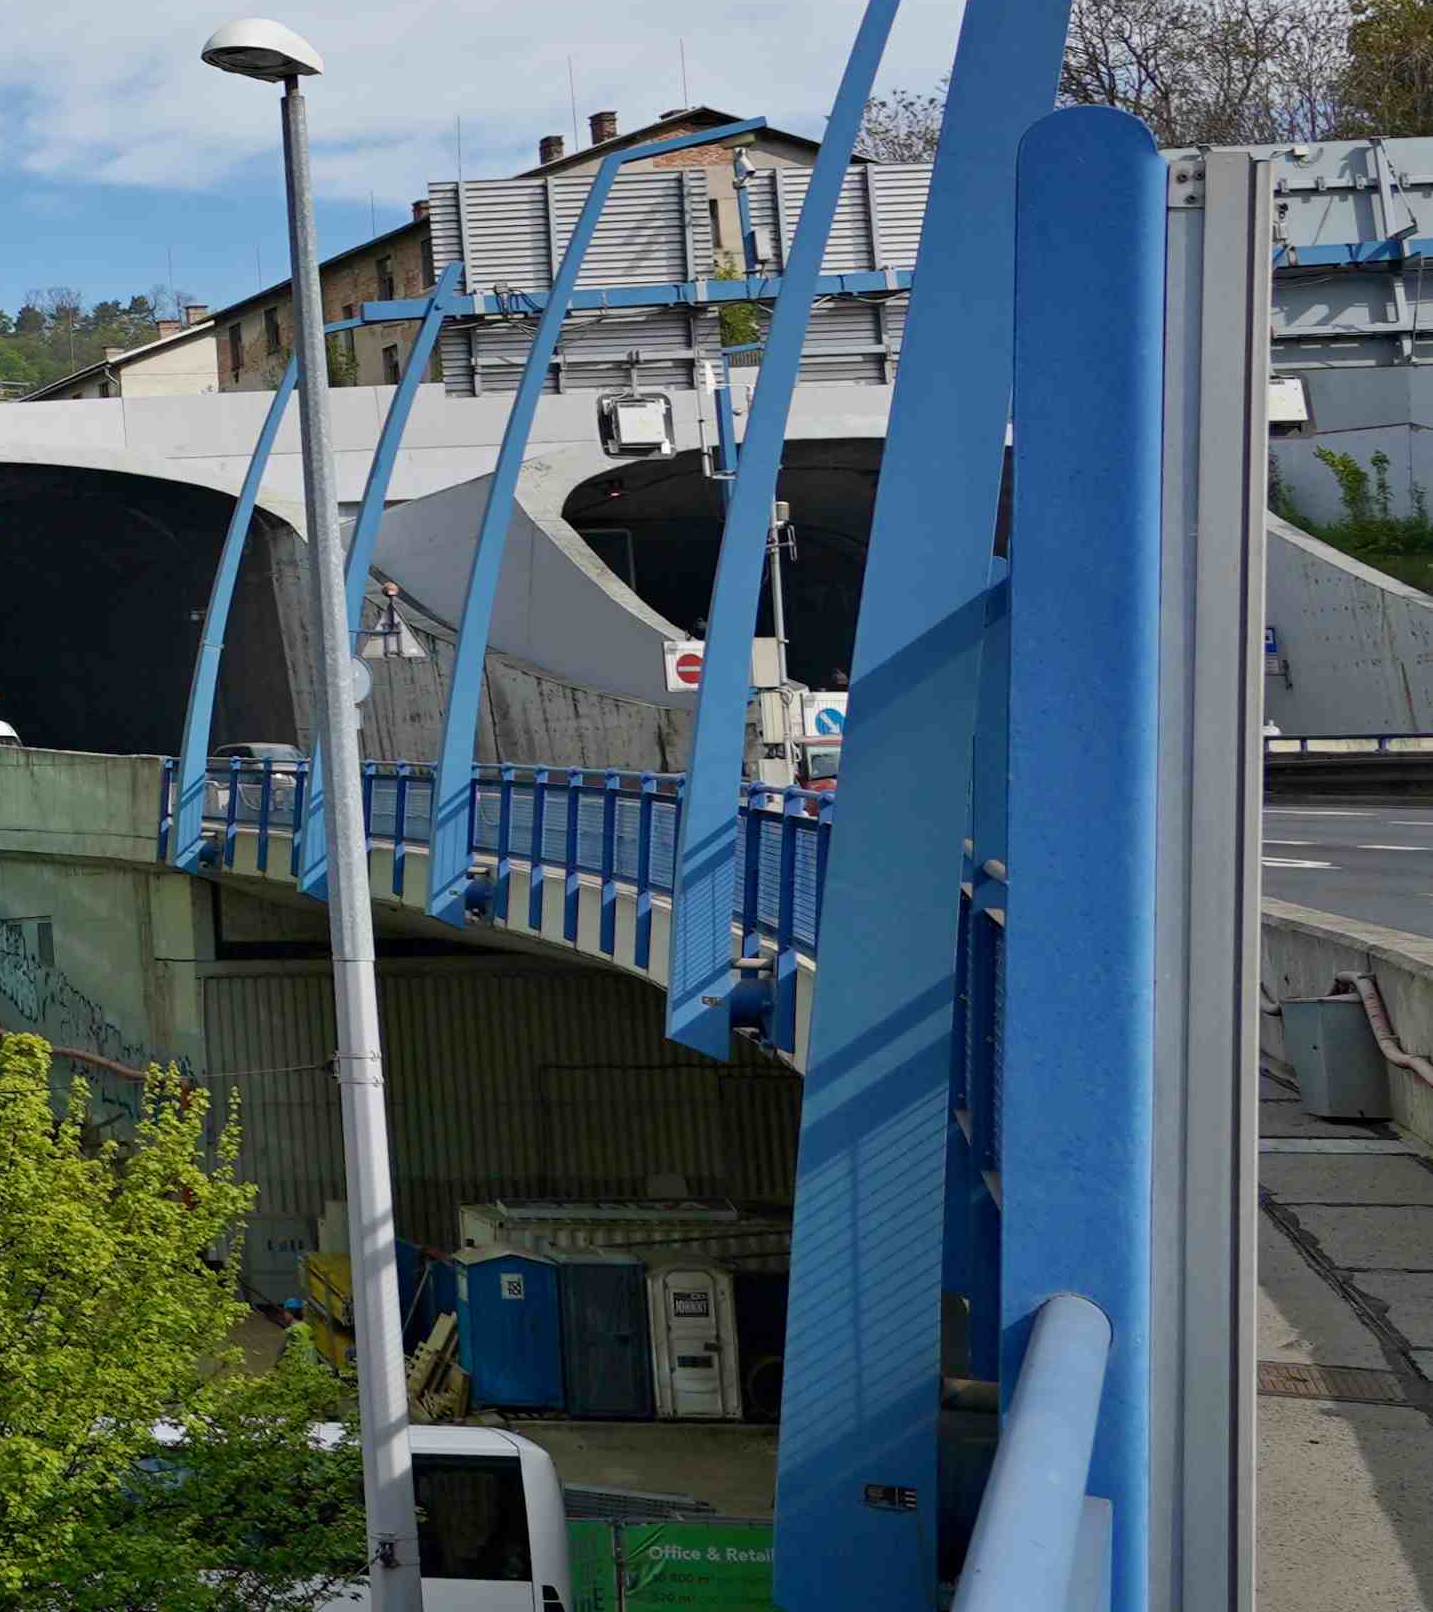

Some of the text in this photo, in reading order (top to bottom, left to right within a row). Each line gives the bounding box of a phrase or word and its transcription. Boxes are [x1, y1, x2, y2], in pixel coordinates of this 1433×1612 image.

[649, 1545, 774, 1563] Office & Retail
